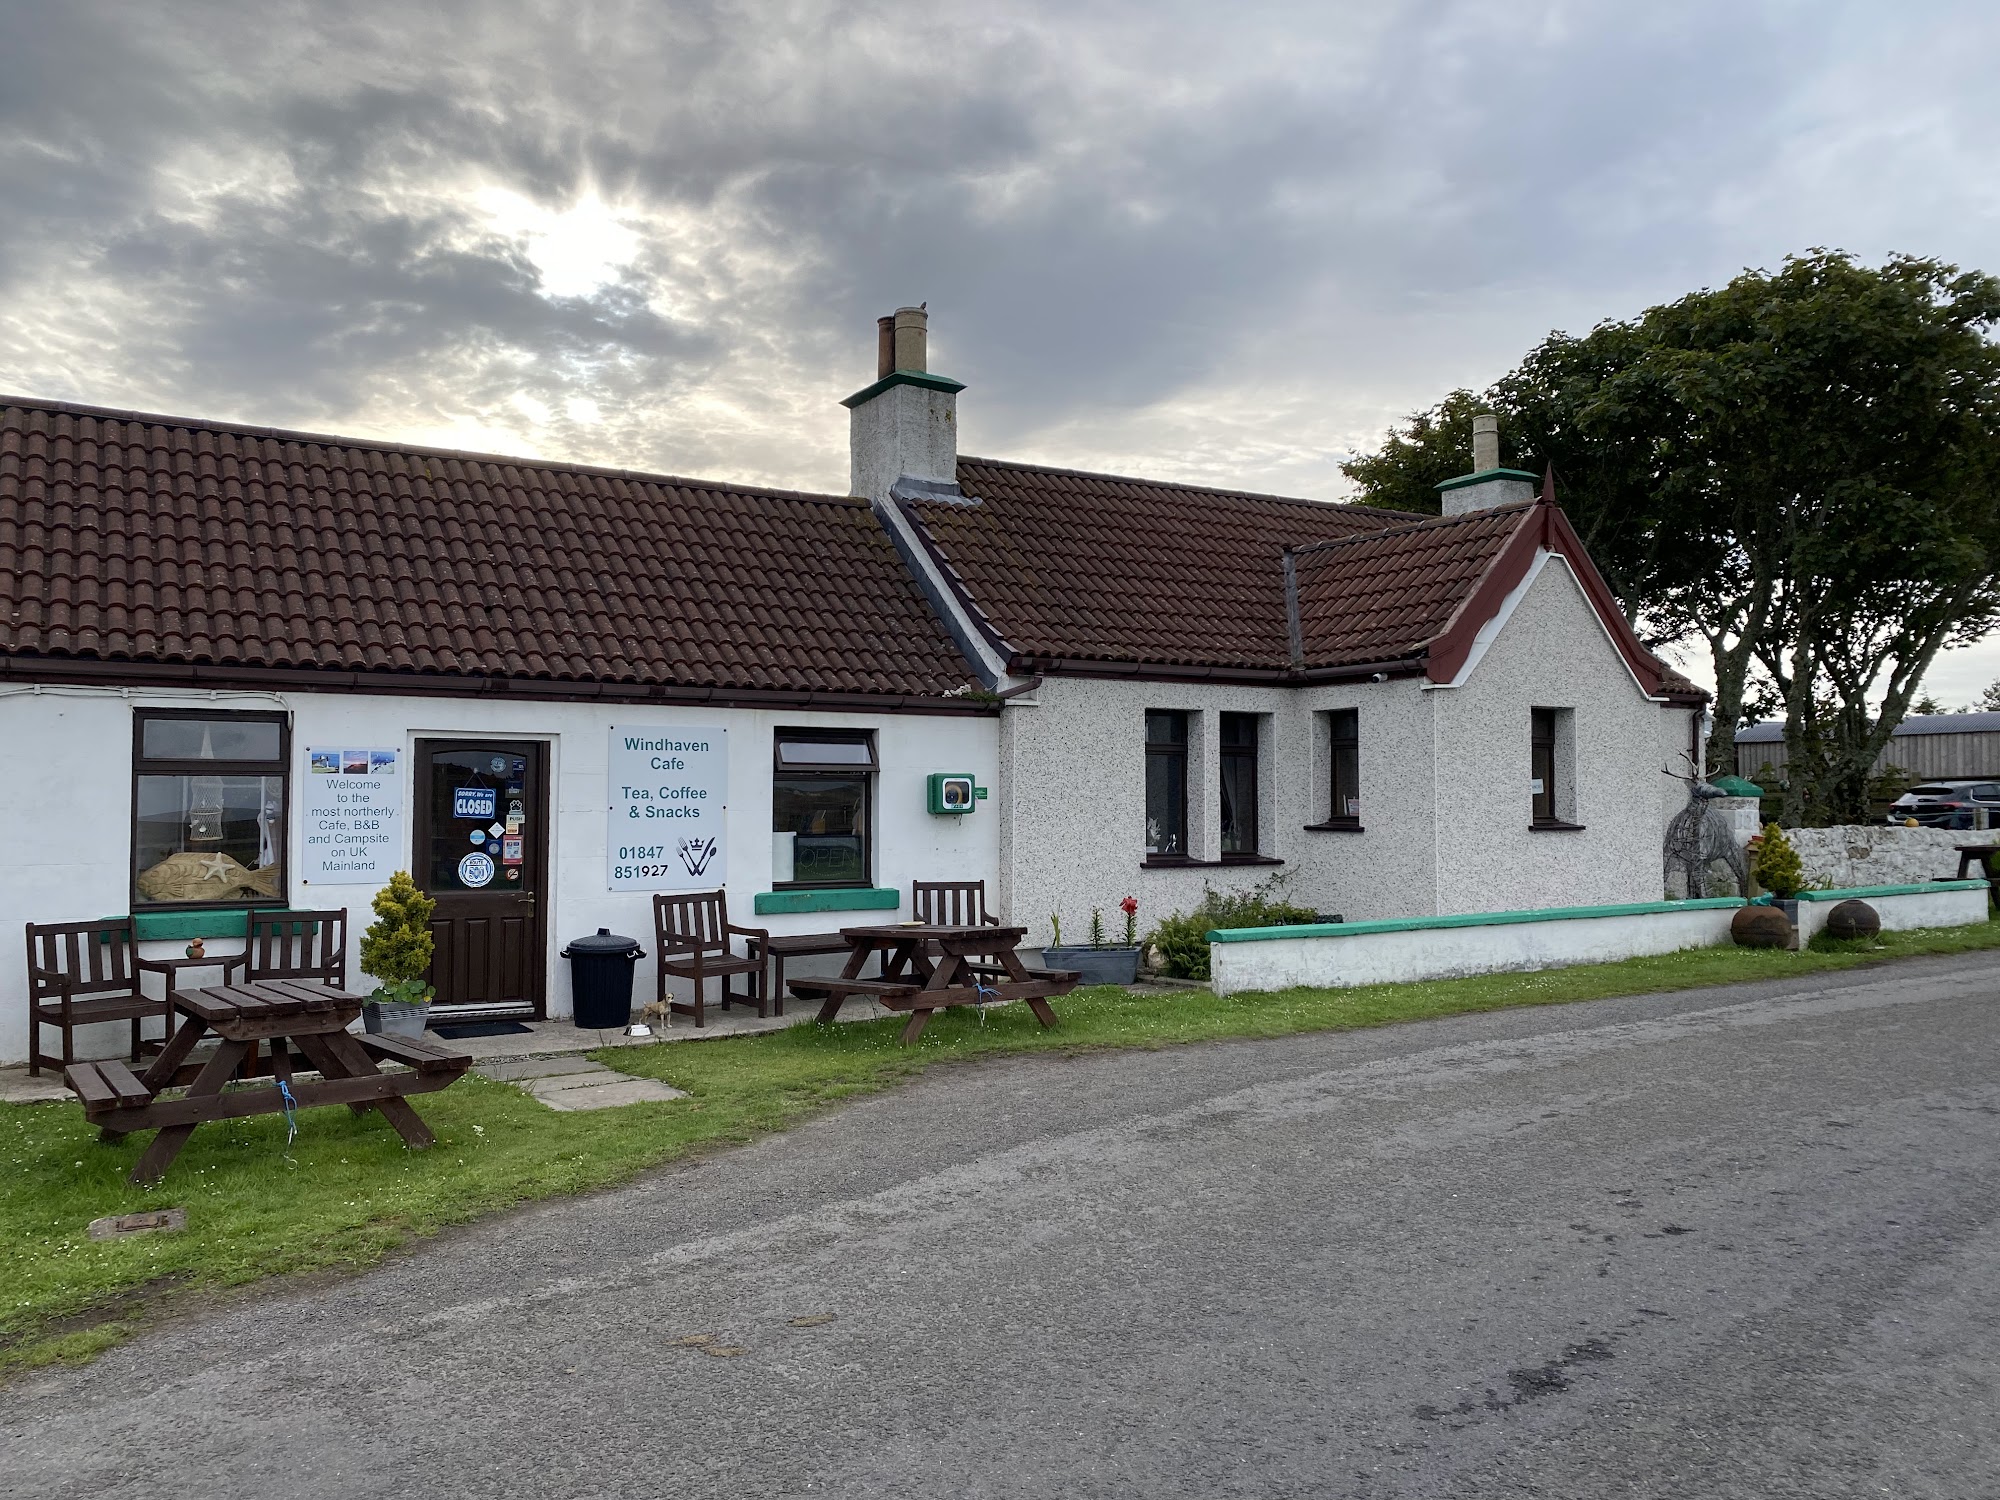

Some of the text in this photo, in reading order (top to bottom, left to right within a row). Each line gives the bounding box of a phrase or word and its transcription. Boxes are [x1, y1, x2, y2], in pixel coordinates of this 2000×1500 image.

[624, 737, 709, 752] Windhaven
[650, 757, 685, 770] Cafe
[326, 779, 381, 790] Welcome
[337, 792, 370, 803] to the
[622, 786, 708, 801] Tea, Coffee
[311, 806, 395, 818] most northerly
[456, 799, 492, 814] CLOSED
[628, 805, 700, 818] & Snacks
[318, 820, 380, 831] Cafe, B&B
[308, 833, 390, 846] and Campsite
[331, 846, 368, 857] on UK
[619, 846, 664, 860] 01847
[800, 848, 854, 868] OPEN
[322, 861, 376, 871] Mainland
[614, 864, 669, 879] 851927
